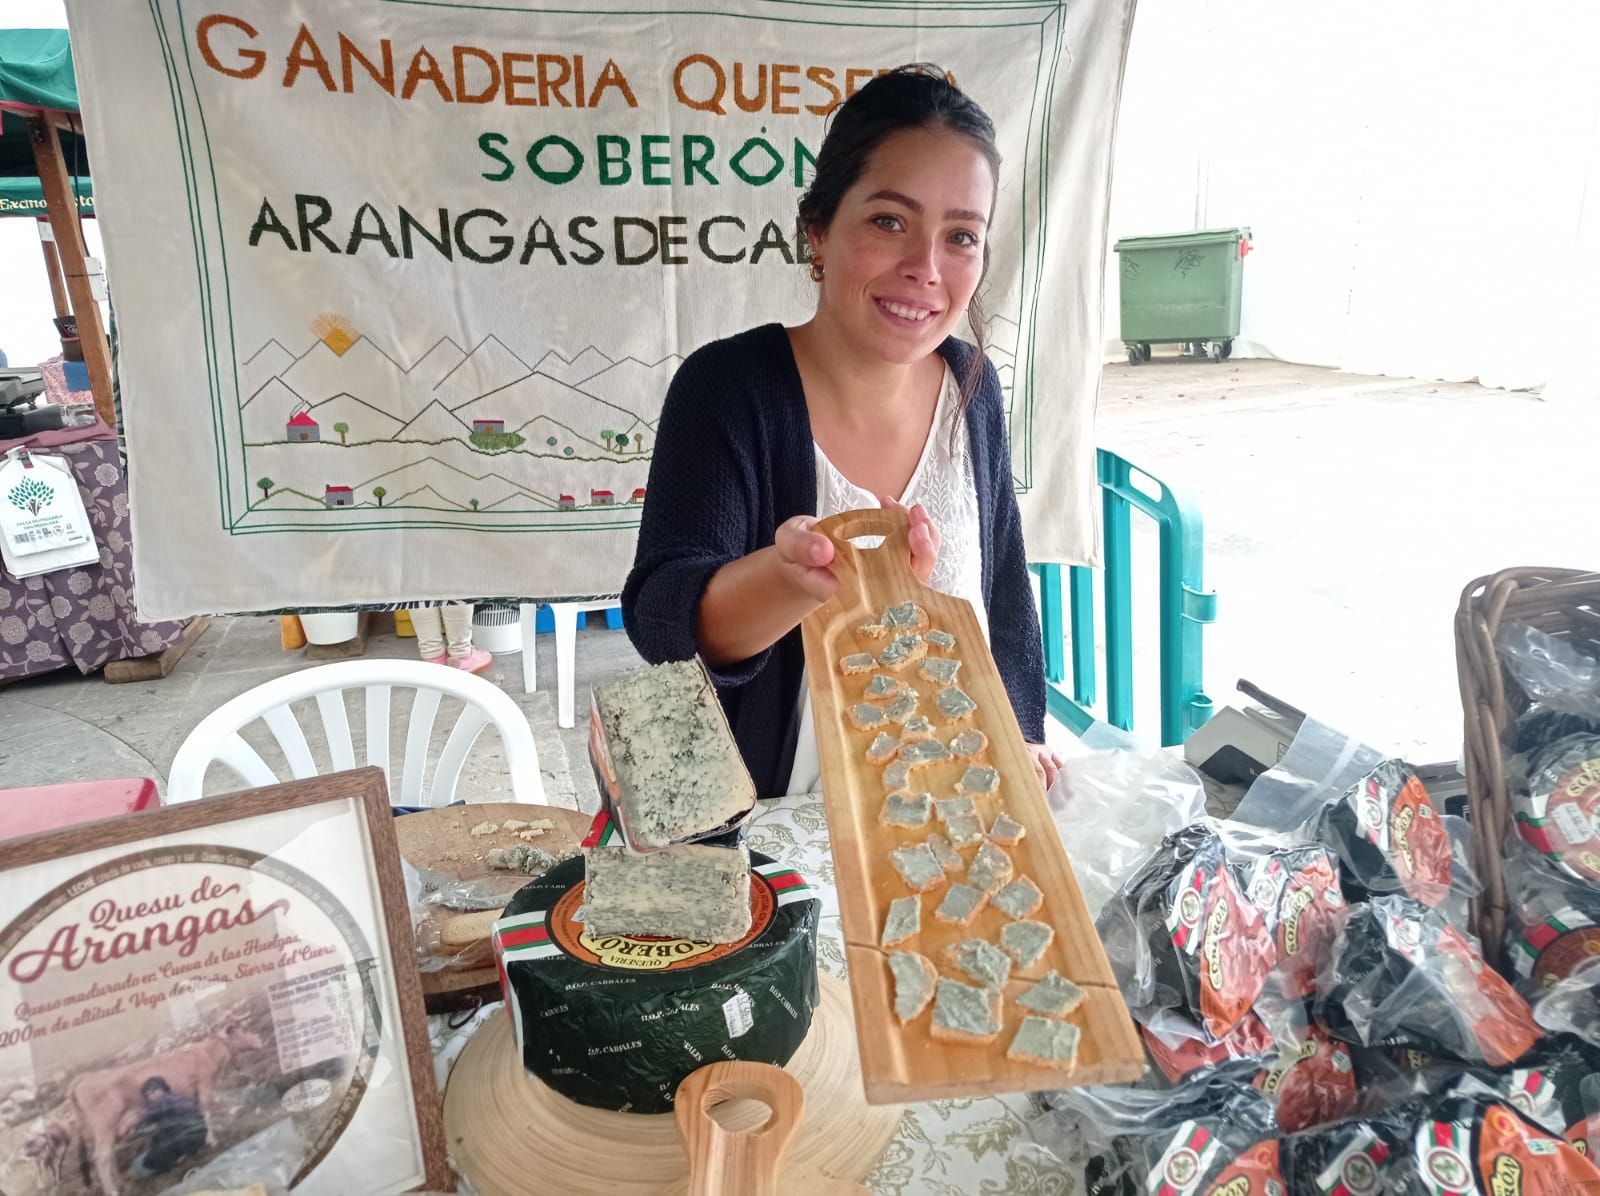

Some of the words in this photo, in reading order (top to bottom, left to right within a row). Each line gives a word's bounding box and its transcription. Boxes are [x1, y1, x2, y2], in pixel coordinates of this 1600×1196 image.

[196, 14, 638, 108] GANADERIA
[672, 52, 957, 116] QUESE
[248, 194, 604, 266] ARANGAS
[89, 894, 184, 932] Quesu
[190, 875, 241, 904] de
[8, 898, 290, 984] Arangas
[610, 954, 662, 967] QUESERIA
[14, 999, 63, 1022] Queso
[63, 973, 139, 1005] madurado
[159, 961, 201, 979] Cueva
[204, 952, 220, 967] de
[222, 948, 242, 963] las
[50, 1015, 70, 1033] de
[129, 991, 167, 1010] Vega
[234, 961, 275, 980] Sierra
[277, 949, 297, 968] del
[590, 978, 637, 987] CABRALES
